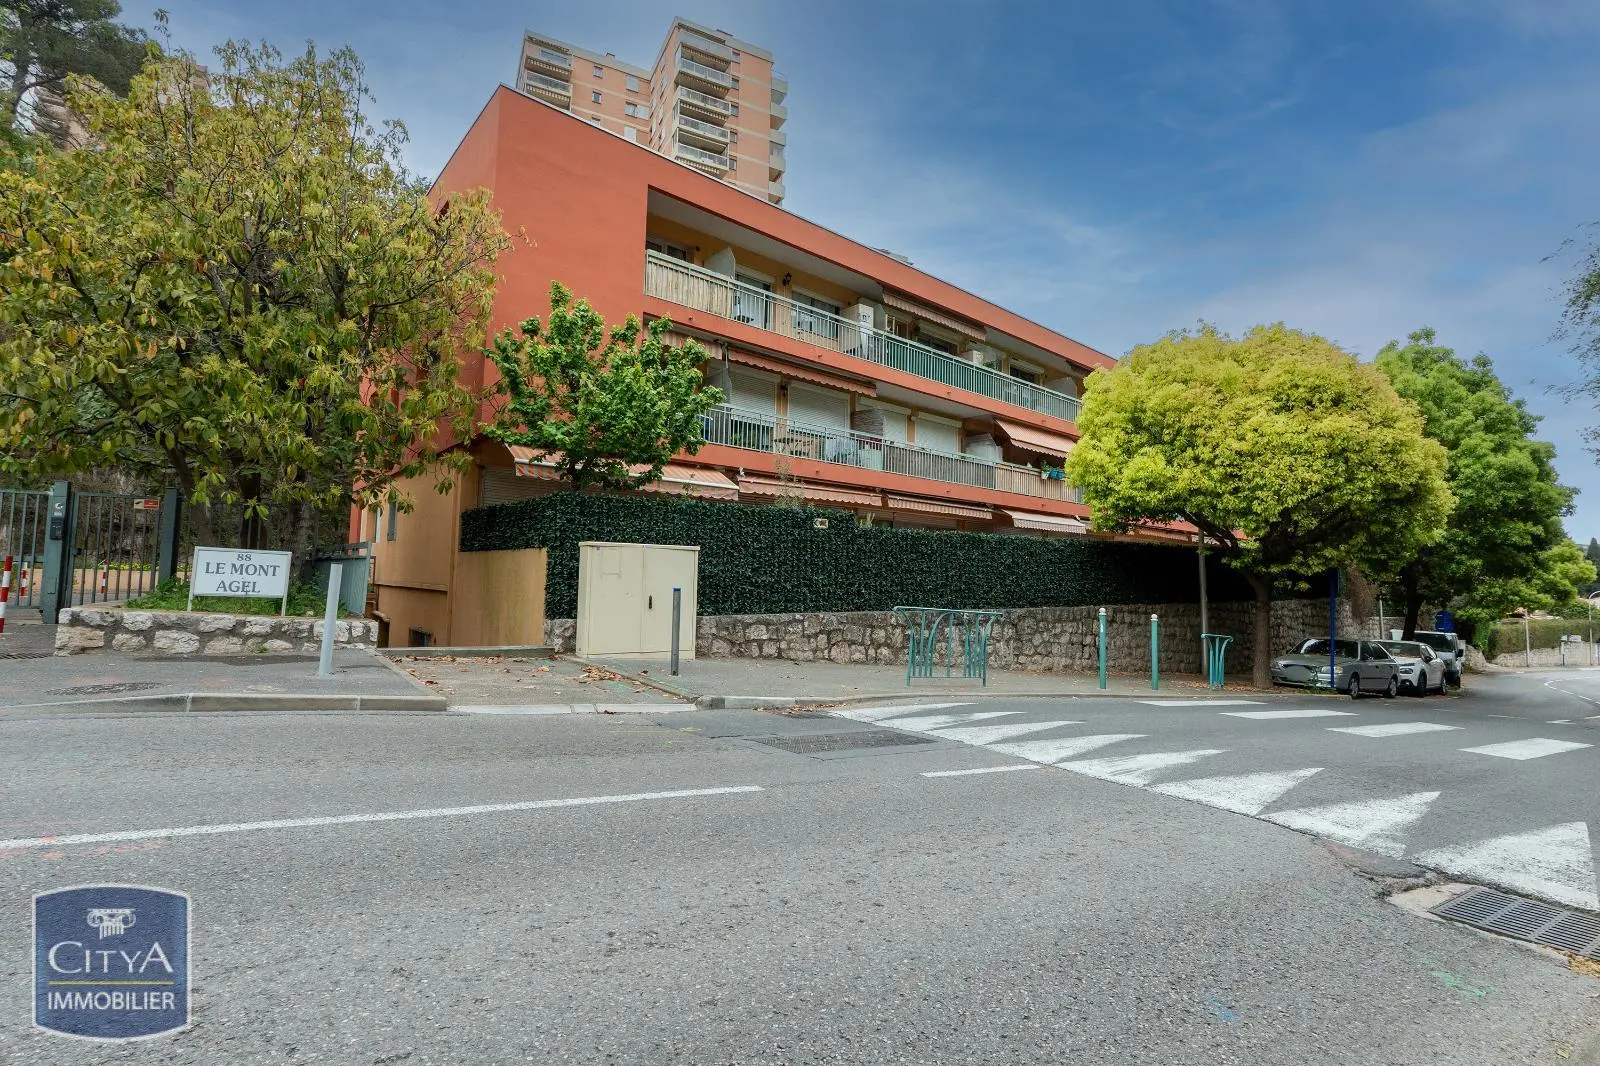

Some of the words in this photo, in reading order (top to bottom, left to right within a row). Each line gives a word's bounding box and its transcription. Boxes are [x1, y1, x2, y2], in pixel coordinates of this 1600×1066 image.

[236, 553, 252, 562] 88
[204, 561, 226, 575] LE
[230, 562, 280, 577] MONT
[216, 580, 261, 593] AGEL
